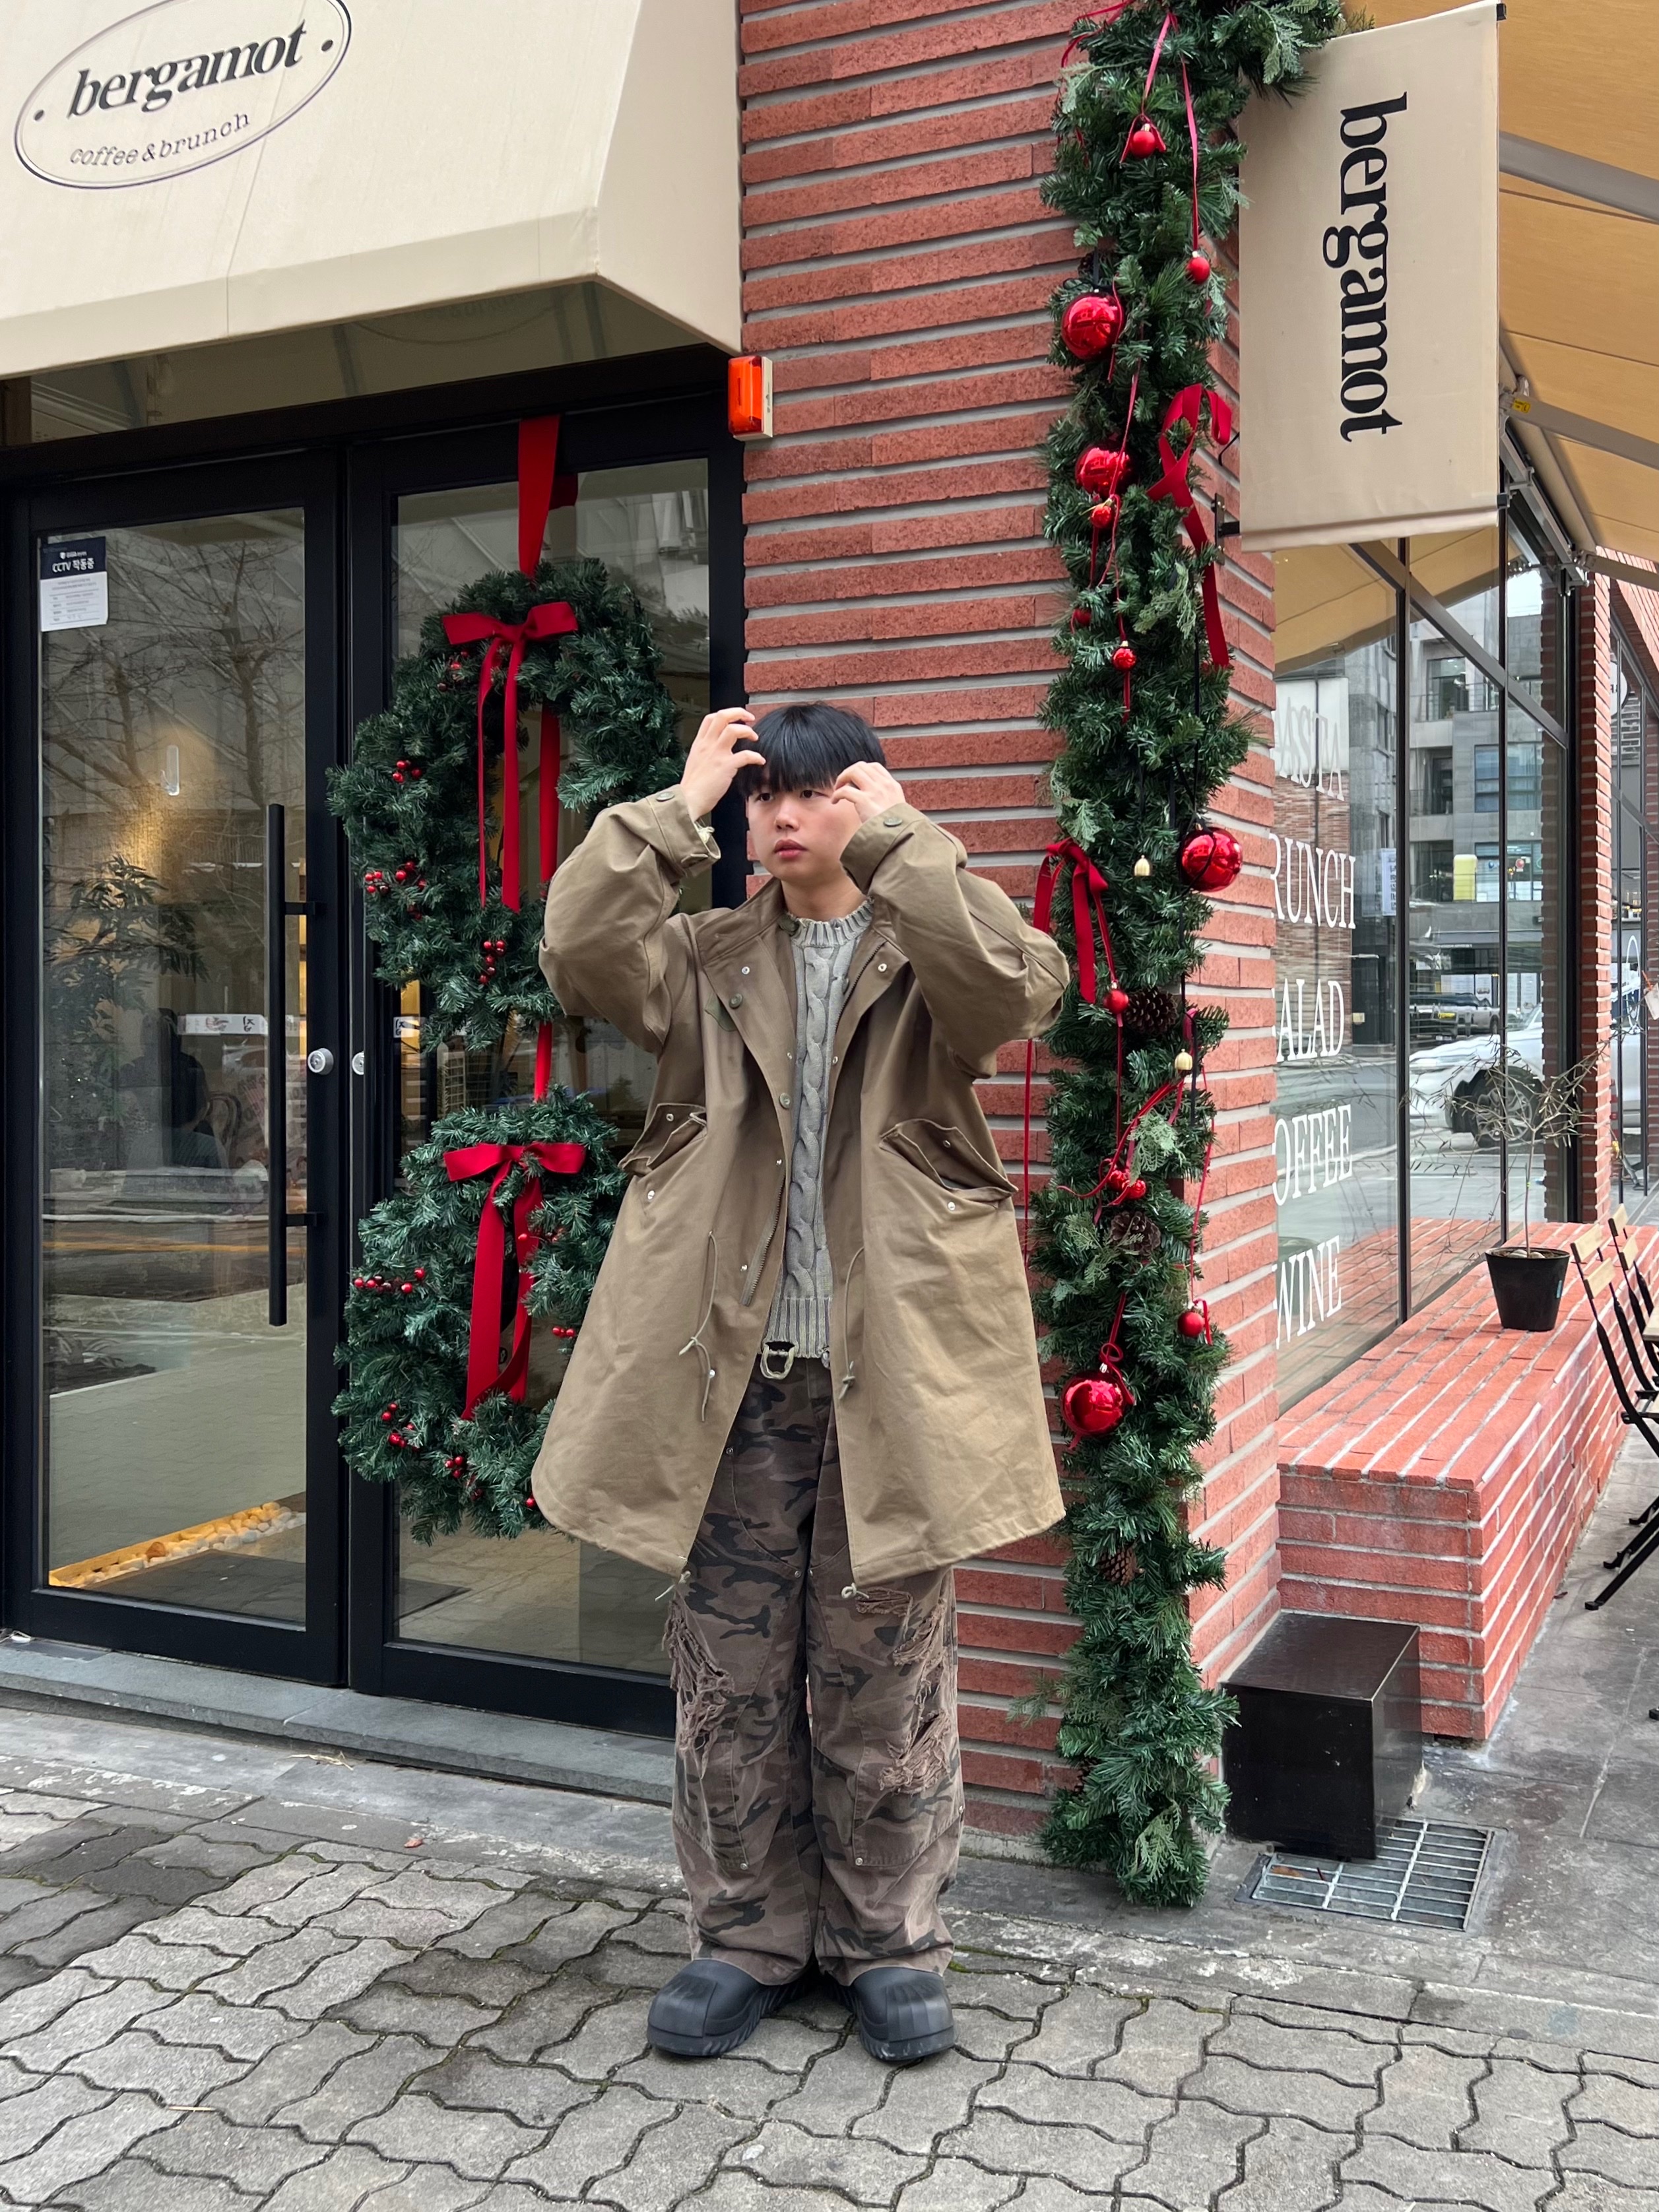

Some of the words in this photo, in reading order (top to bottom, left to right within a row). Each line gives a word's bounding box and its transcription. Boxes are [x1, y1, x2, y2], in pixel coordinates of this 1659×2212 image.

[66, 18, 307, 119] bergamot
[1322, 91, 1408, 443] bergamot
[52, 561, 71, 573] CCTV
[1274, 696, 1345, 802] ASTA
[1269, 833, 1356, 929] RUNCH
[1271, 977, 1345, 1062] ALAD
[1271, 1104, 1352, 1206] OFFEE
